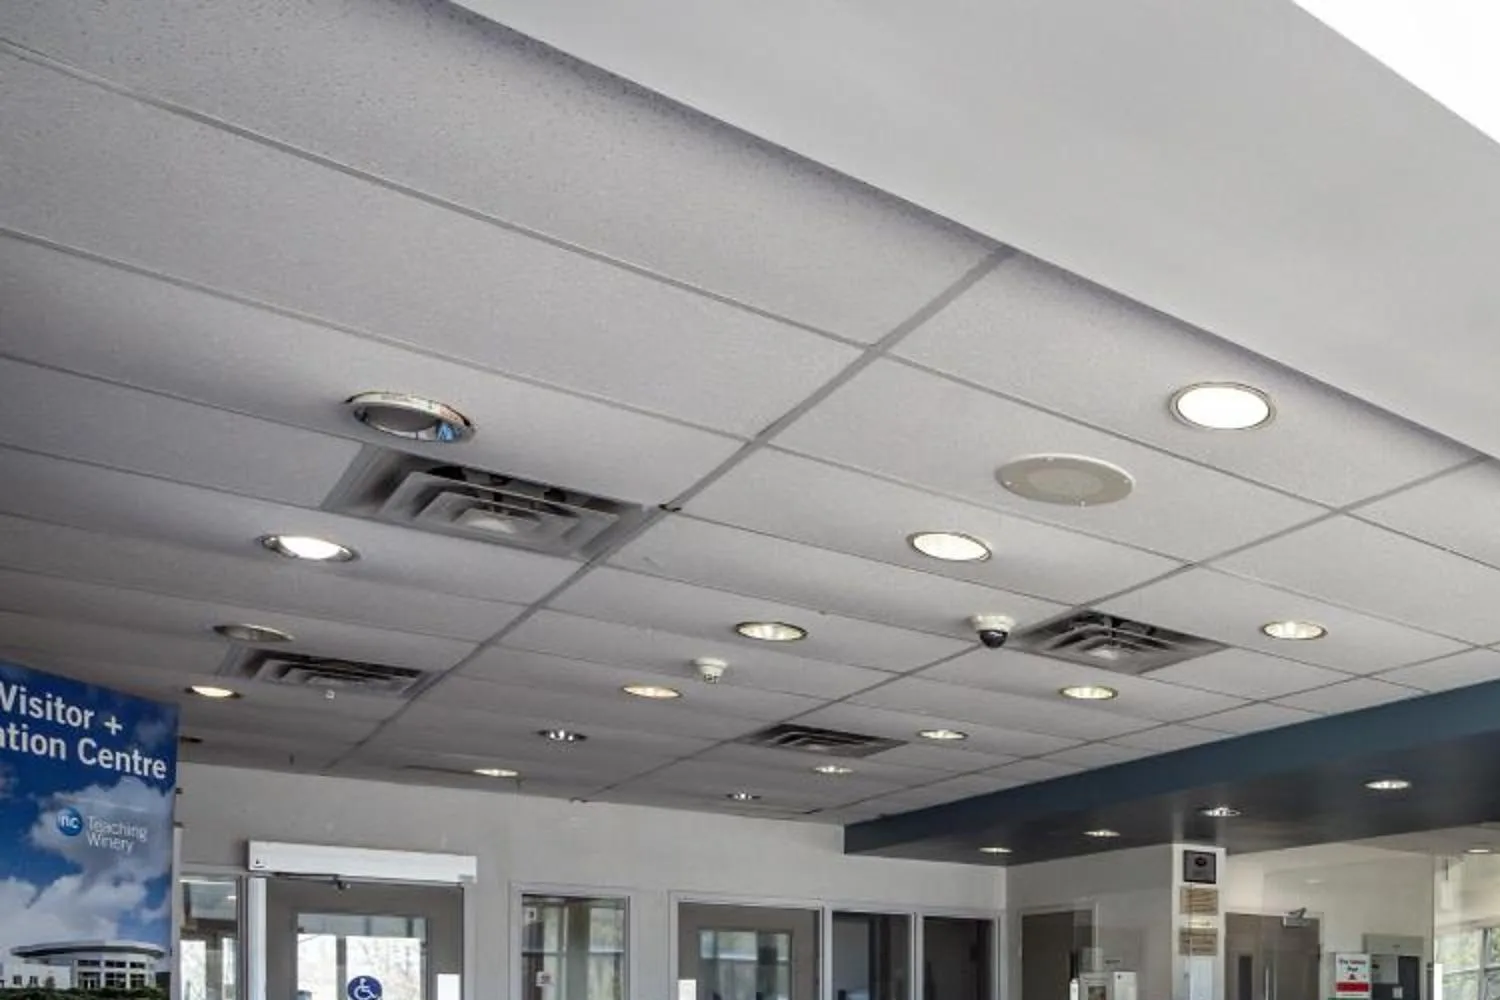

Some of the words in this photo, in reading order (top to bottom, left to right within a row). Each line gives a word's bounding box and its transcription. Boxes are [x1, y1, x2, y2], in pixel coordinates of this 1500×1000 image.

[0, 681, 95, 730] Visitor
[77, 737, 167, 779] Centre
[86, 832, 134, 855] Winery
[87, 815, 147, 843] Teaching
